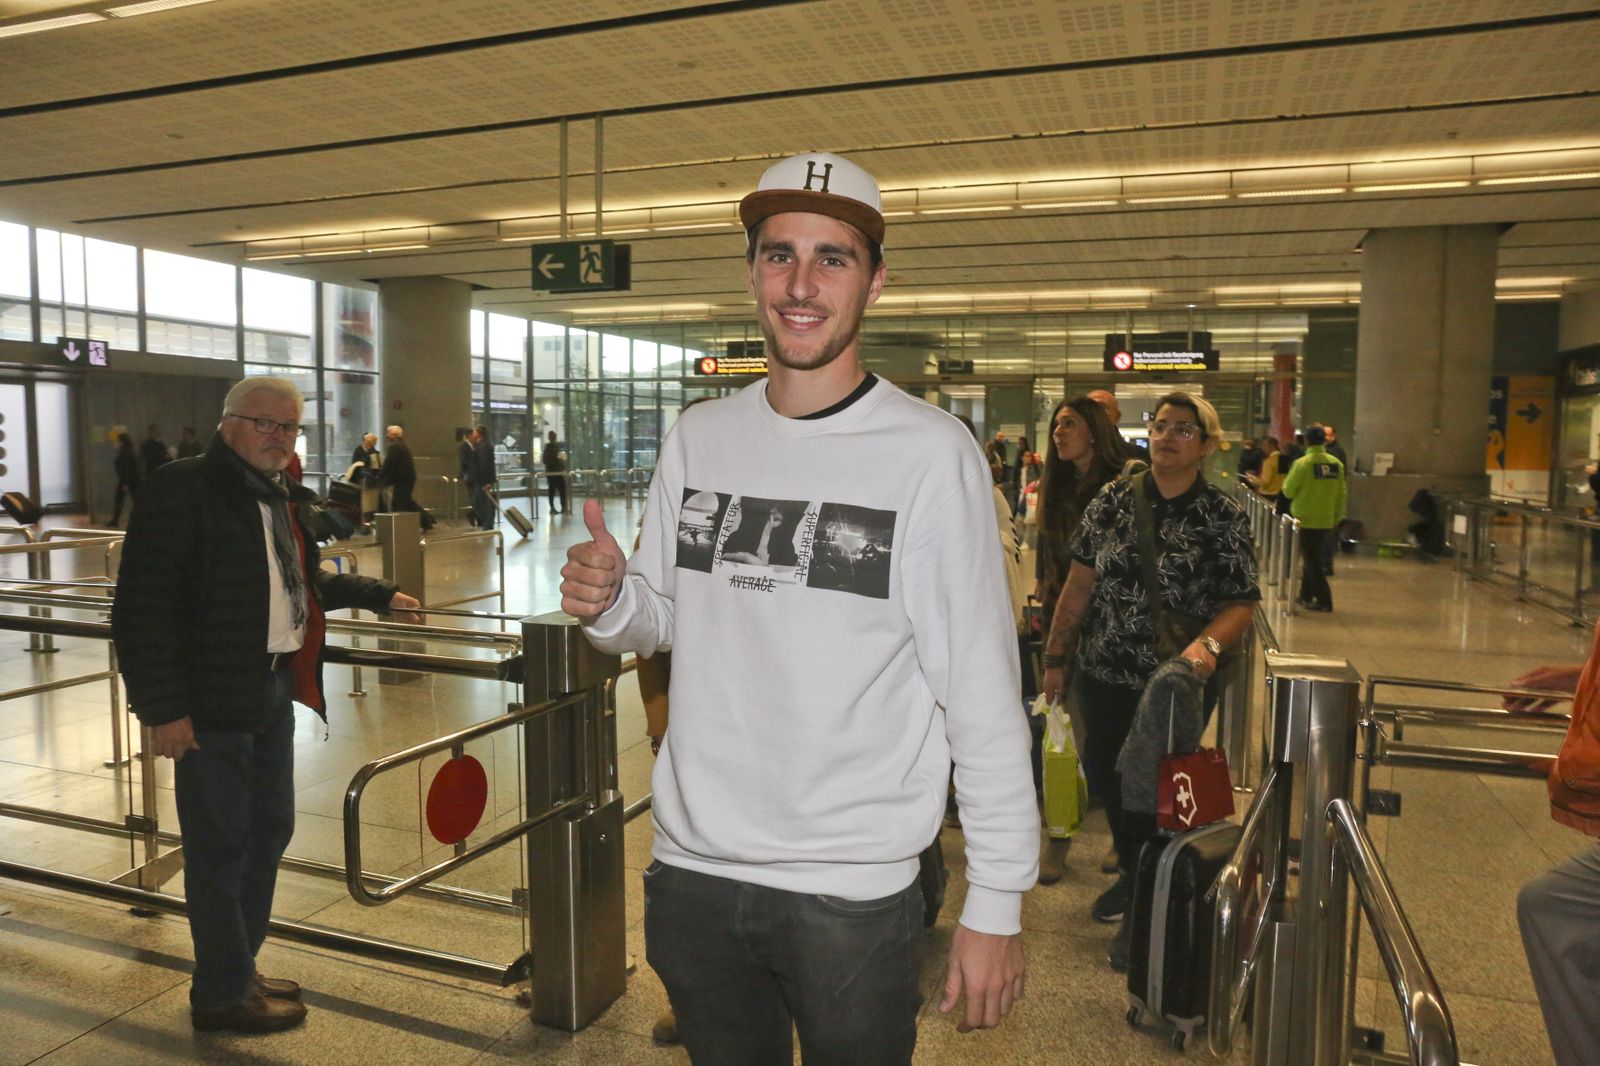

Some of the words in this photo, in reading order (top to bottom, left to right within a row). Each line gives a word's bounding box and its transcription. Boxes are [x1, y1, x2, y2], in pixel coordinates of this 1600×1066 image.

[803, 161, 833, 193] H
[714, 501, 742, 567] SPECTATOR
[729, 574, 776, 592] AVERAGE
